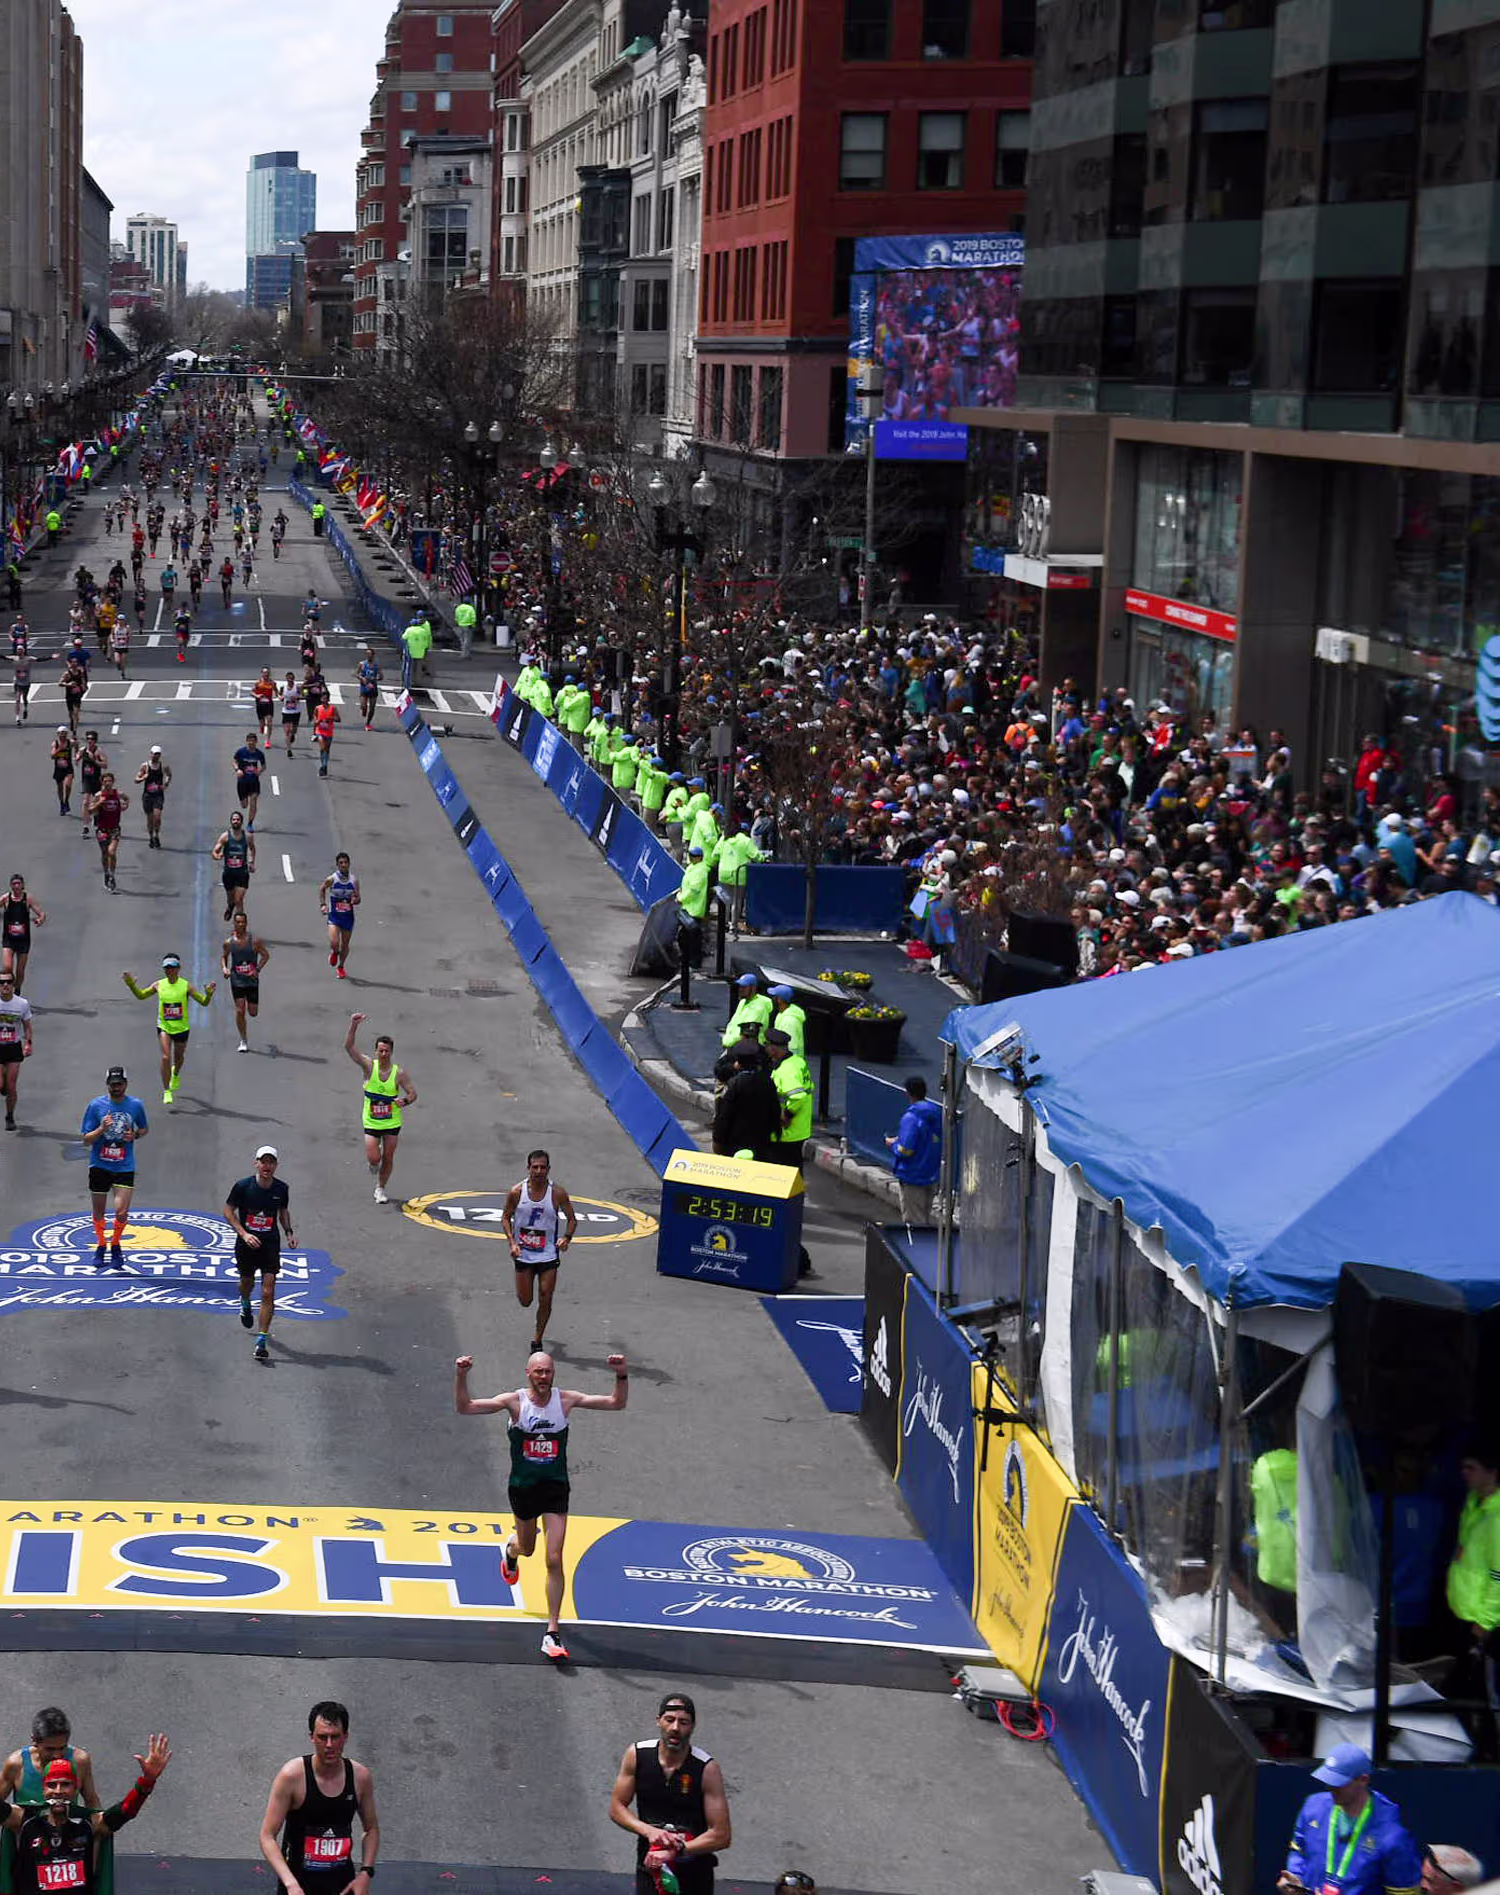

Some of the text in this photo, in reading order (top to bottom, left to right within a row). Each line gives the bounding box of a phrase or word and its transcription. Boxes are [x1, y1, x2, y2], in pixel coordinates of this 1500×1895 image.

[953, 238, 1024, 251] 2019 BOSTO
[952, 250, 1024, 263] MARATHO
[438, 1205, 619, 1223] 12RD
[688, 1196, 772, 1227] 2:53:19
[102, 1251, 308, 1267] OSTN
[530, 1440, 553, 1453] 1429
[623, 1567, 934, 1600] BOSTON MARATHON
[661, 1591, 918, 1630] John Hancock
[313, 1838, 344, 1856] 1907
[45, 1863, 77, 1883] 1218
